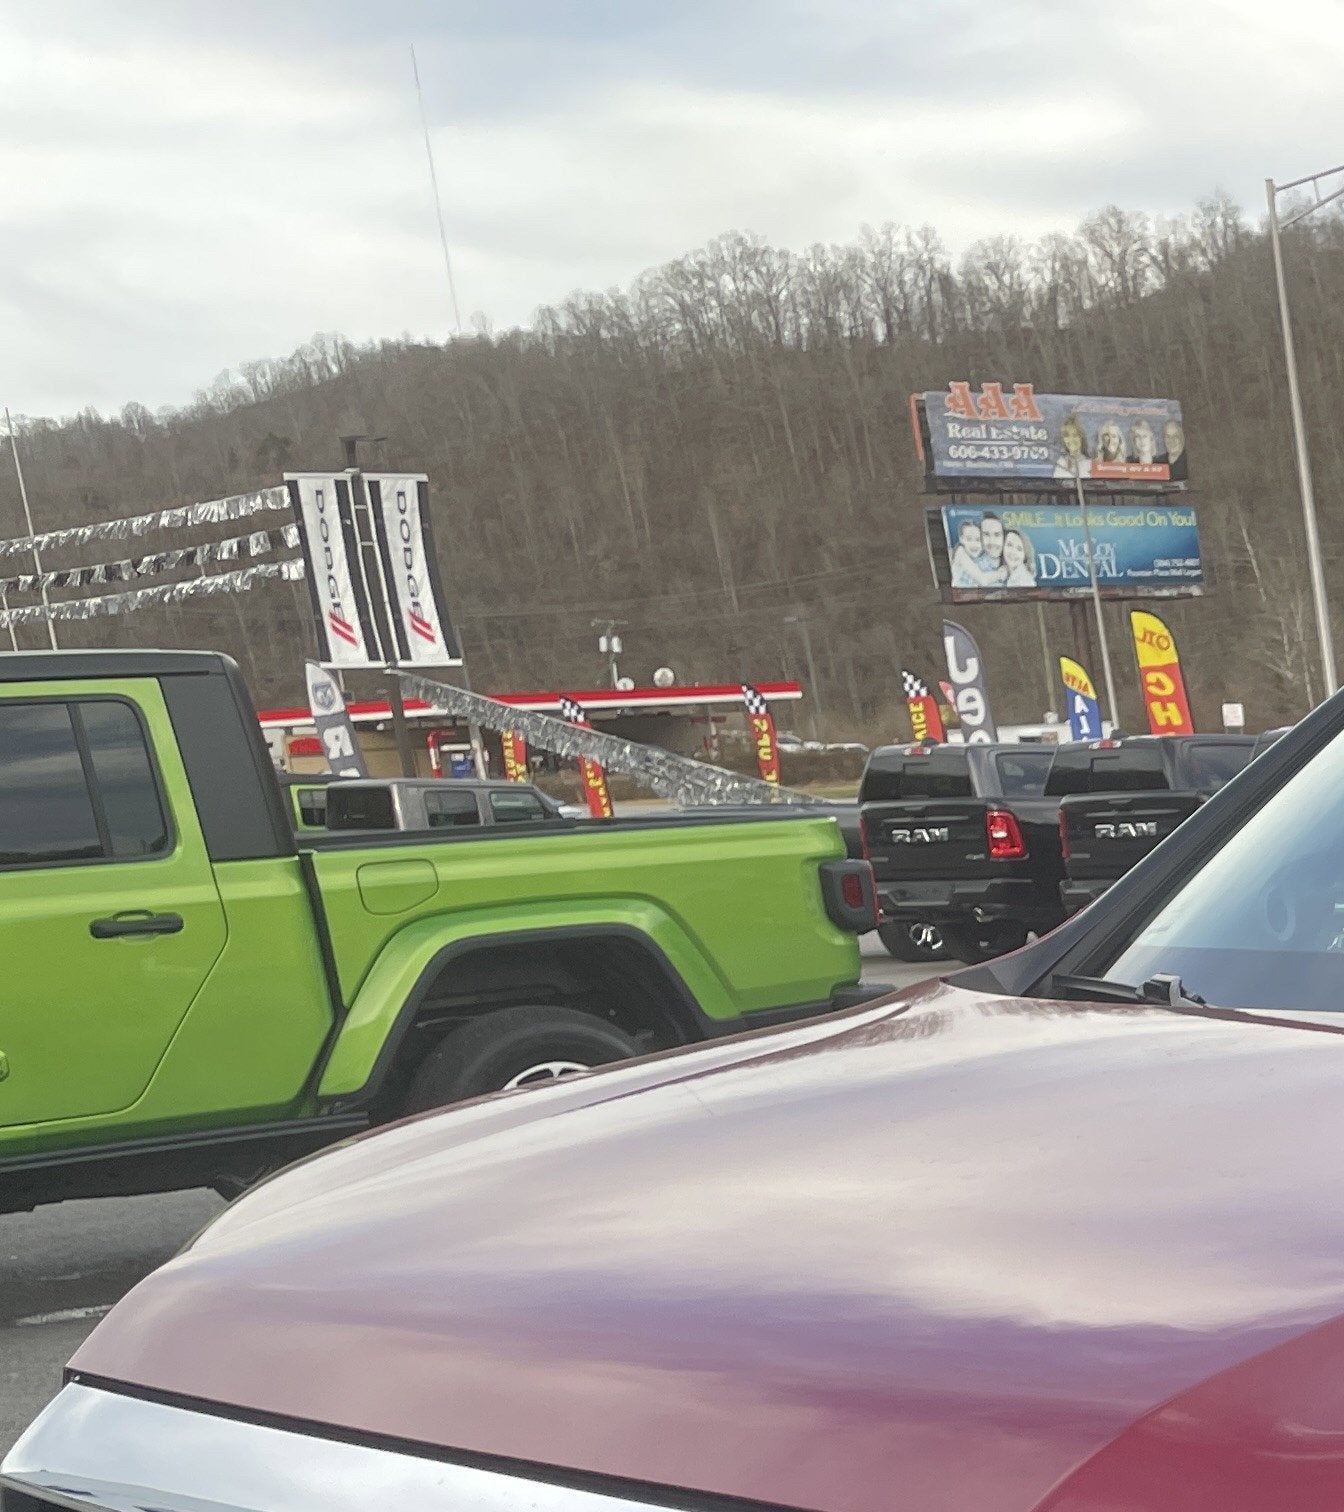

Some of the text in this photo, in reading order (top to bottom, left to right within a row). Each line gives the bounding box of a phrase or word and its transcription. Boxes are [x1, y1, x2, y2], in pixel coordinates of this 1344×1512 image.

[944, 381, 1044, 421] AAA
[947, 423, 987, 439] Real
[1065, 511, 1104, 527] Loks
[1107, 511, 1144, 527] Good
[1146, 511, 1168, 527] On
[1038, 553, 1124, 579] DENAL
[892, 827, 950, 844] RAM
[1094, 821, 1159, 839] RAM
